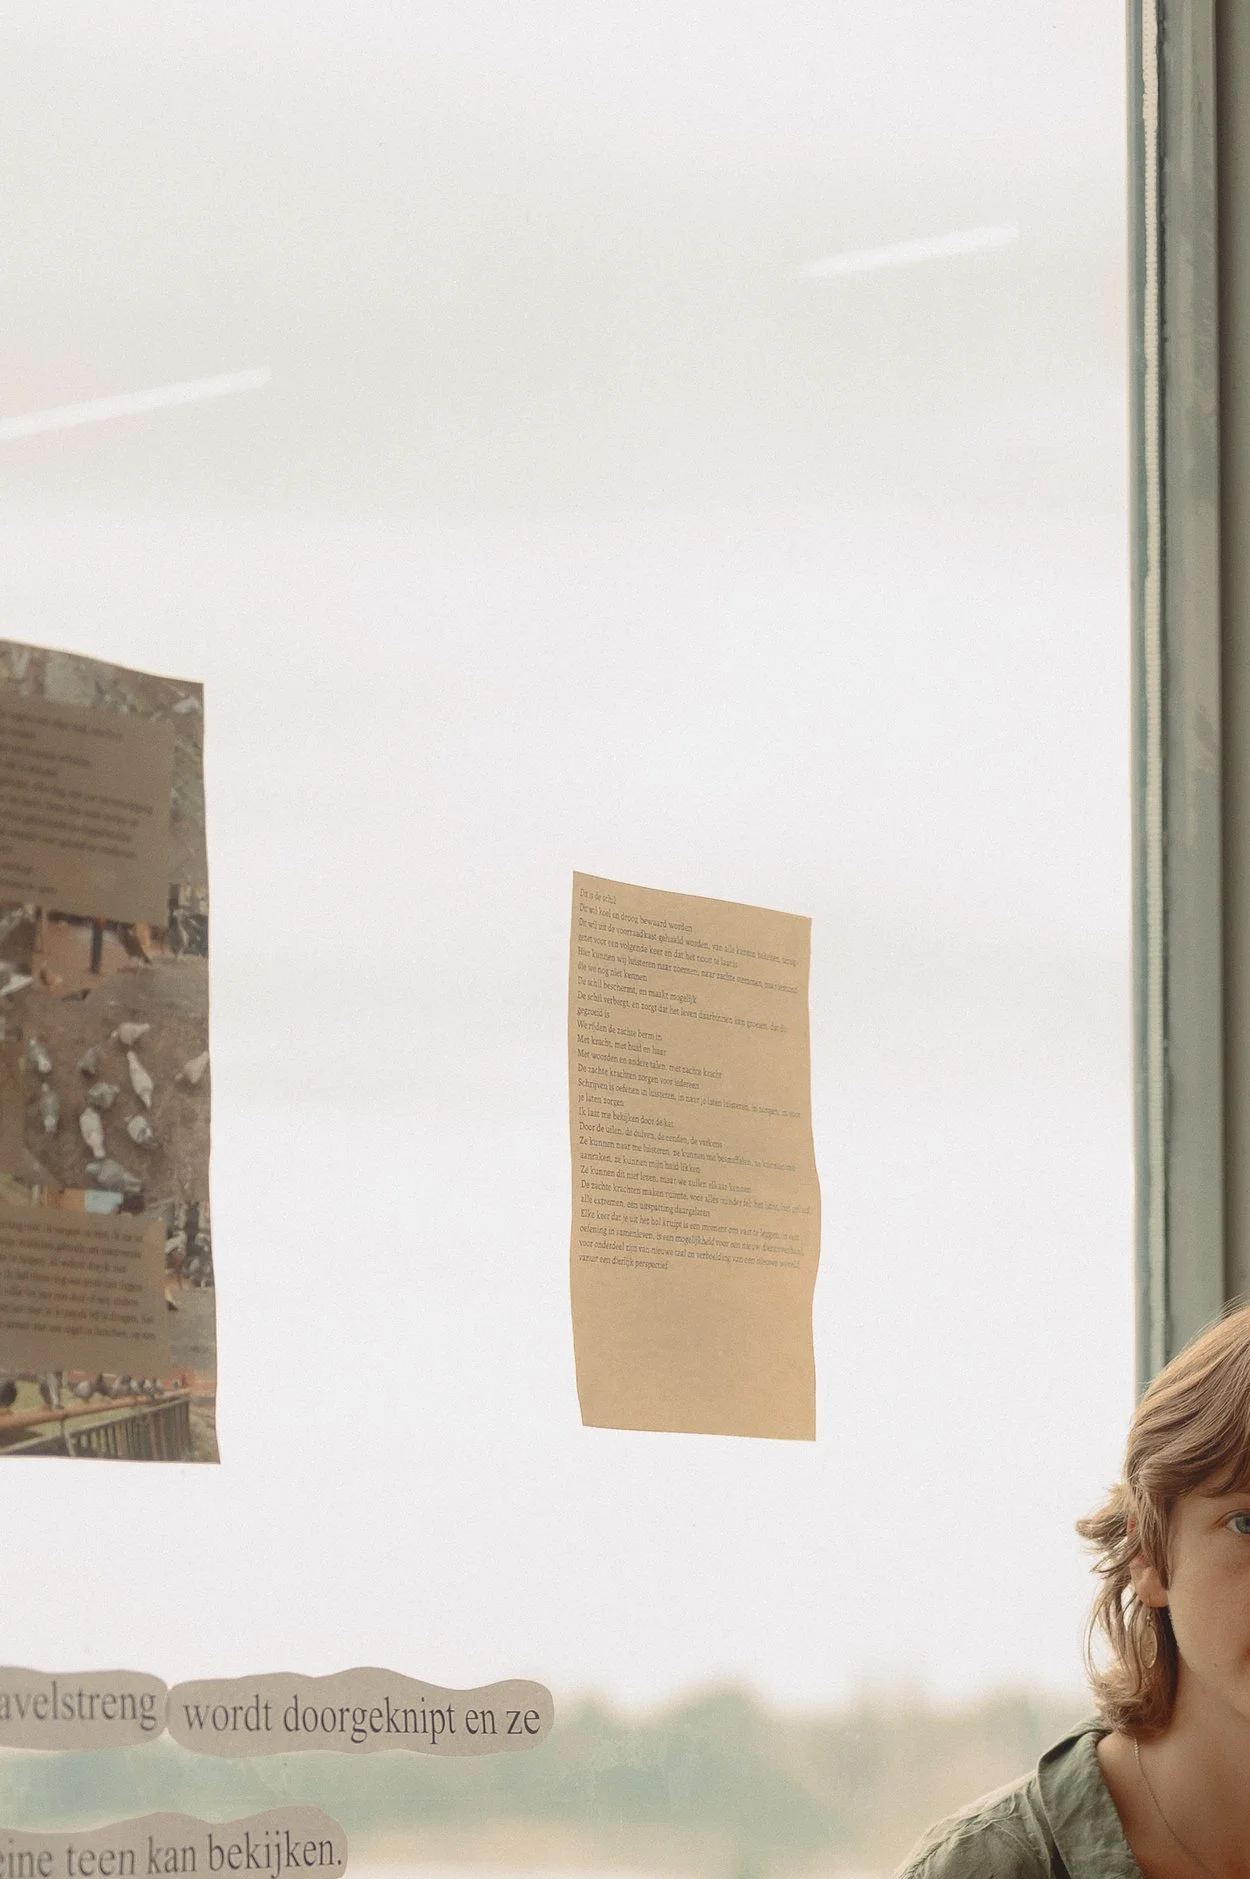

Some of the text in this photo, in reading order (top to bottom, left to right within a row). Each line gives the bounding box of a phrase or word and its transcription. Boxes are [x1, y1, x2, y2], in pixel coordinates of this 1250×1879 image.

[597, 966, 609, 976] nog
[587, 992, 602, 1002] schil
[668, 1004, 679, 1014] het
[588, 1020, 606, 1032] rijden
[585, 1092, 601, 1102] laten
[603, 1097, 624, 1108] zorgen
[587, 1108, 599, 1118] laat
[640, 1115, 654, 1125] door
[579, 1120, 594, 1131] Door
[589, 1136, 614, 1147] kunnen
[622, 1154, 647, 1166] kunnen
[590, 1165, 614, 1176] kunnen
[616, 1168, 624, 1177] dit
[626, 1169, 638, 1179] niet
[591, 1181, 611, 1191] zachte
[612, 1182, 640, 1194] krachten
[641, 1186, 663, 1196] maken
[580, 1193, 592, 1203] alle
[580, 1209, 594, 1219] Elke
[596, 1210, 609, 1220] keer
[650, 1215, 660, 1225] hol
[579, 1223, 607, 1236] oefening
[594, 1239, 624, 1250] onderdeel
[184, 1694, 272, 1732] wordt
[283, 1694, 457, 1745] doorgeknipt
[465, 1707, 498, 1735] en
[506, 1708, 541, 1735] ze
[67, 1843, 136, 1877] teen
[147, 1836, 198, 1875] kan
[208, 1830, 343, 1879] bekijken.
